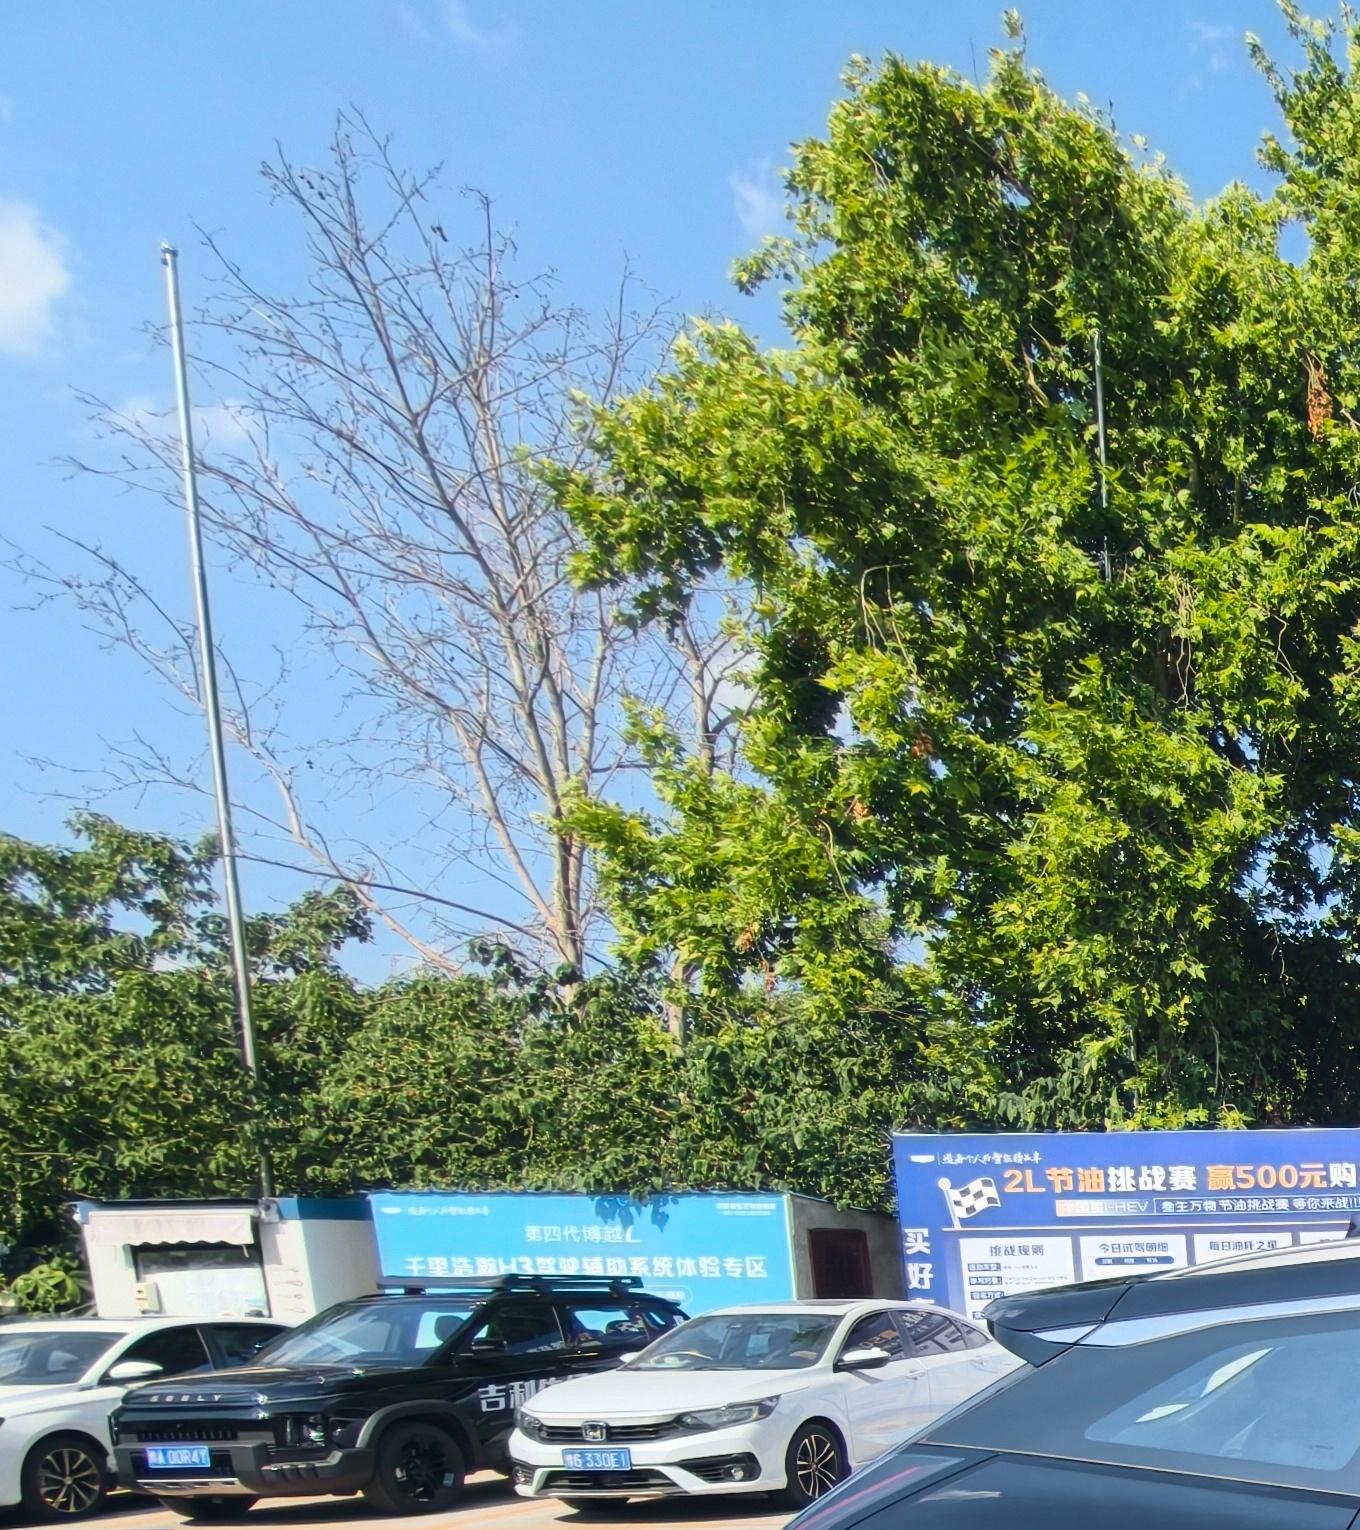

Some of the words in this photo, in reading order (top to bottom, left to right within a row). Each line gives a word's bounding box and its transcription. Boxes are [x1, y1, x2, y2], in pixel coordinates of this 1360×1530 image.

[1003, 1165, 1197, 1193] 2L节油挑战赛
[1219, 1198, 1289, 1211] 节油挑战赛
[989, 1244, 1044, 1257] 挑战规则
[904, 1228, 933, 1304] 买好
